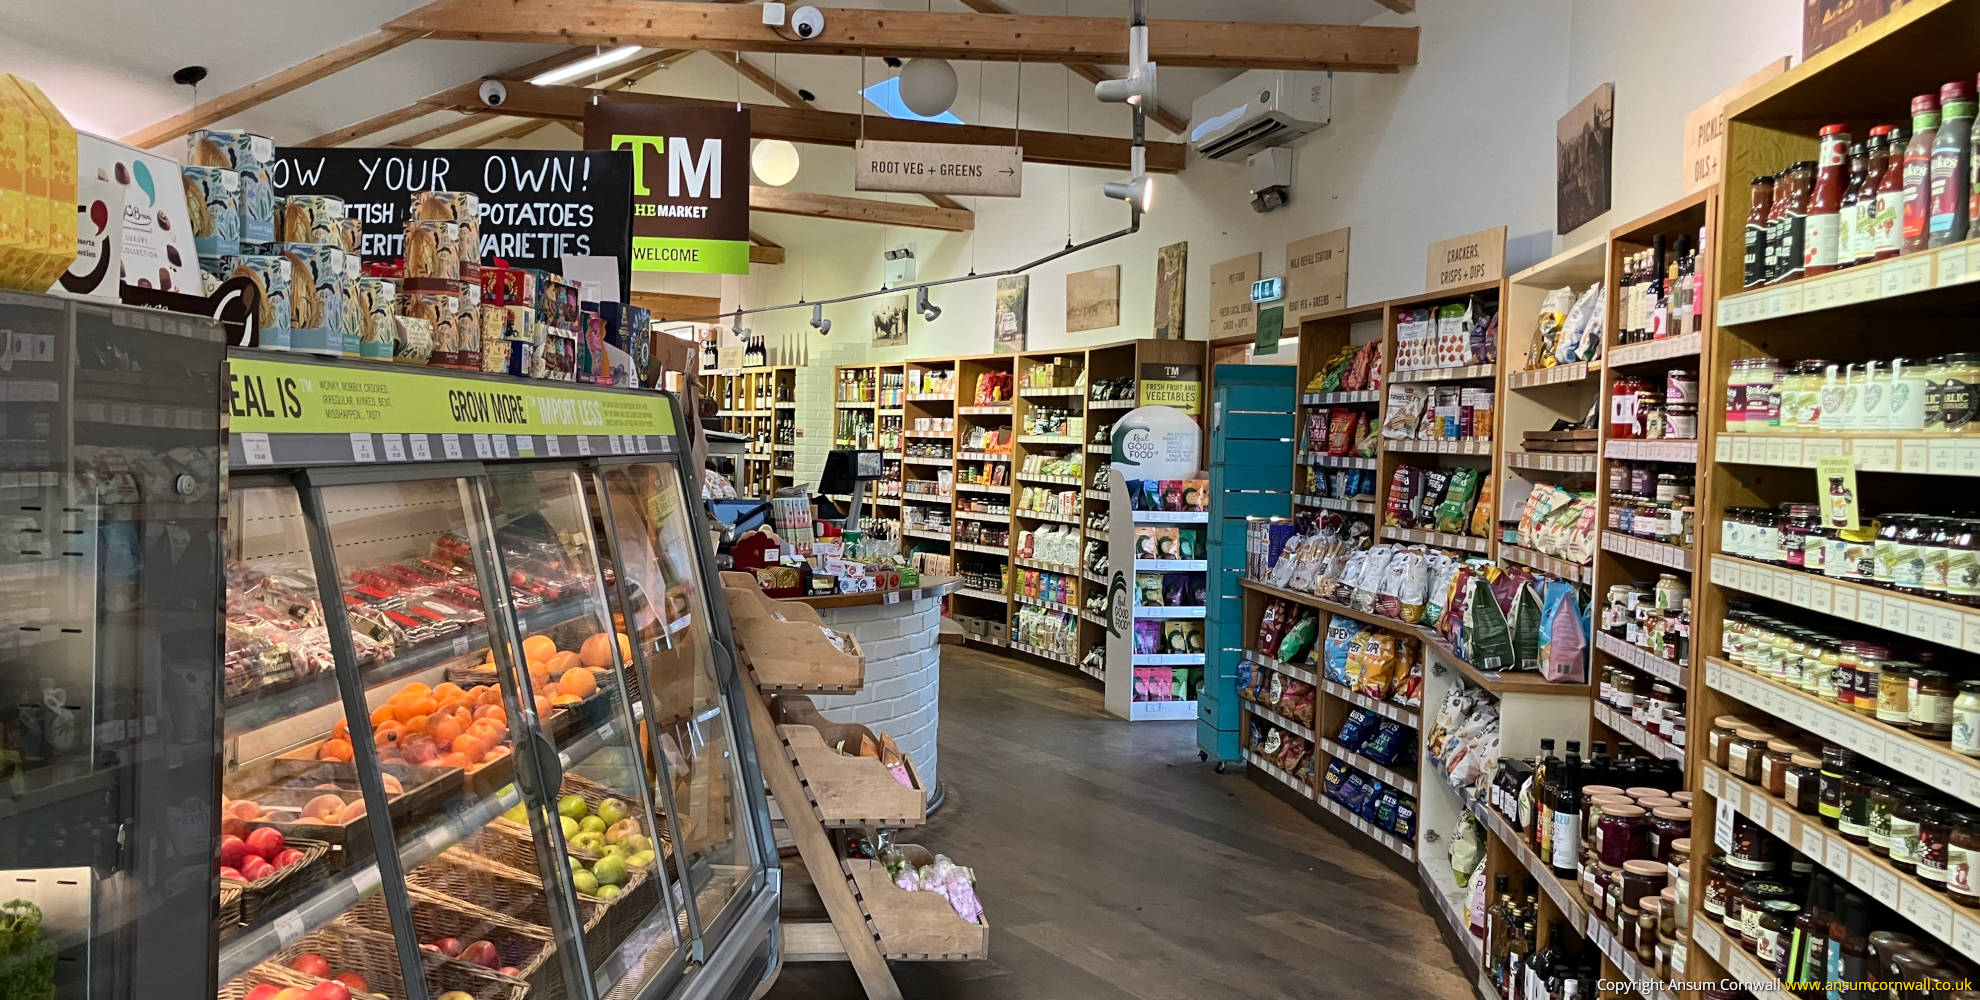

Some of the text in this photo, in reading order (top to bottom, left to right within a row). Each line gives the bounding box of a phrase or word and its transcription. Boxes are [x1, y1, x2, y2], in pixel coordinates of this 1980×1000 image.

[1698, 113, 1723, 148] PICKLE
[274, 155, 591, 193] OW YOUR OWN!
[611, 134, 722, 199] TM
[871, 161, 900, 174] ROOT
[903, 162, 924, 175] VEG
[940, 164, 983, 178] GREENS
[1695, 157, 1709, 183] OILS
[343, 203, 394, 225] TTISH
[478, 203, 594, 228] POTATOES
[634, 203, 708, 219] HE MARKET
[361, 232, 591, 259] ERIT VARIETIES
[632, 247, 699, 262] WELCOME
[1440, 268, 1462, 285] CRISPS
[1470, 263, 1485, 279] DIPS
[1312, 295, 1330, 308] GREENS
[1164, 366, 1180, 376] TM
[1146, 383, 1165, 391] FRESH
[1184, 384, 1196, 392] AND
[229, 374, 275, 418] EAL
[276, 377, 303, 419] IS
[1146, 391, 1196, 402] VEGETABLES
[448, 388, 490, 423] GROW
[490, 392, 527, 425] MORE
[538, 396, 578, 426] IMPORT
[576, 399, 604, 427] LESS
[1133, 433, 1149, 443] Real
[1127, 442, 1154, 451] GOOD
[1129, 451, 1154, 459] FOOD
[1114, 606, 1129, 620] GOOD
[1115, 618, 1129, 631] FOOD
[1923, 858, 1942, 870] TREE
